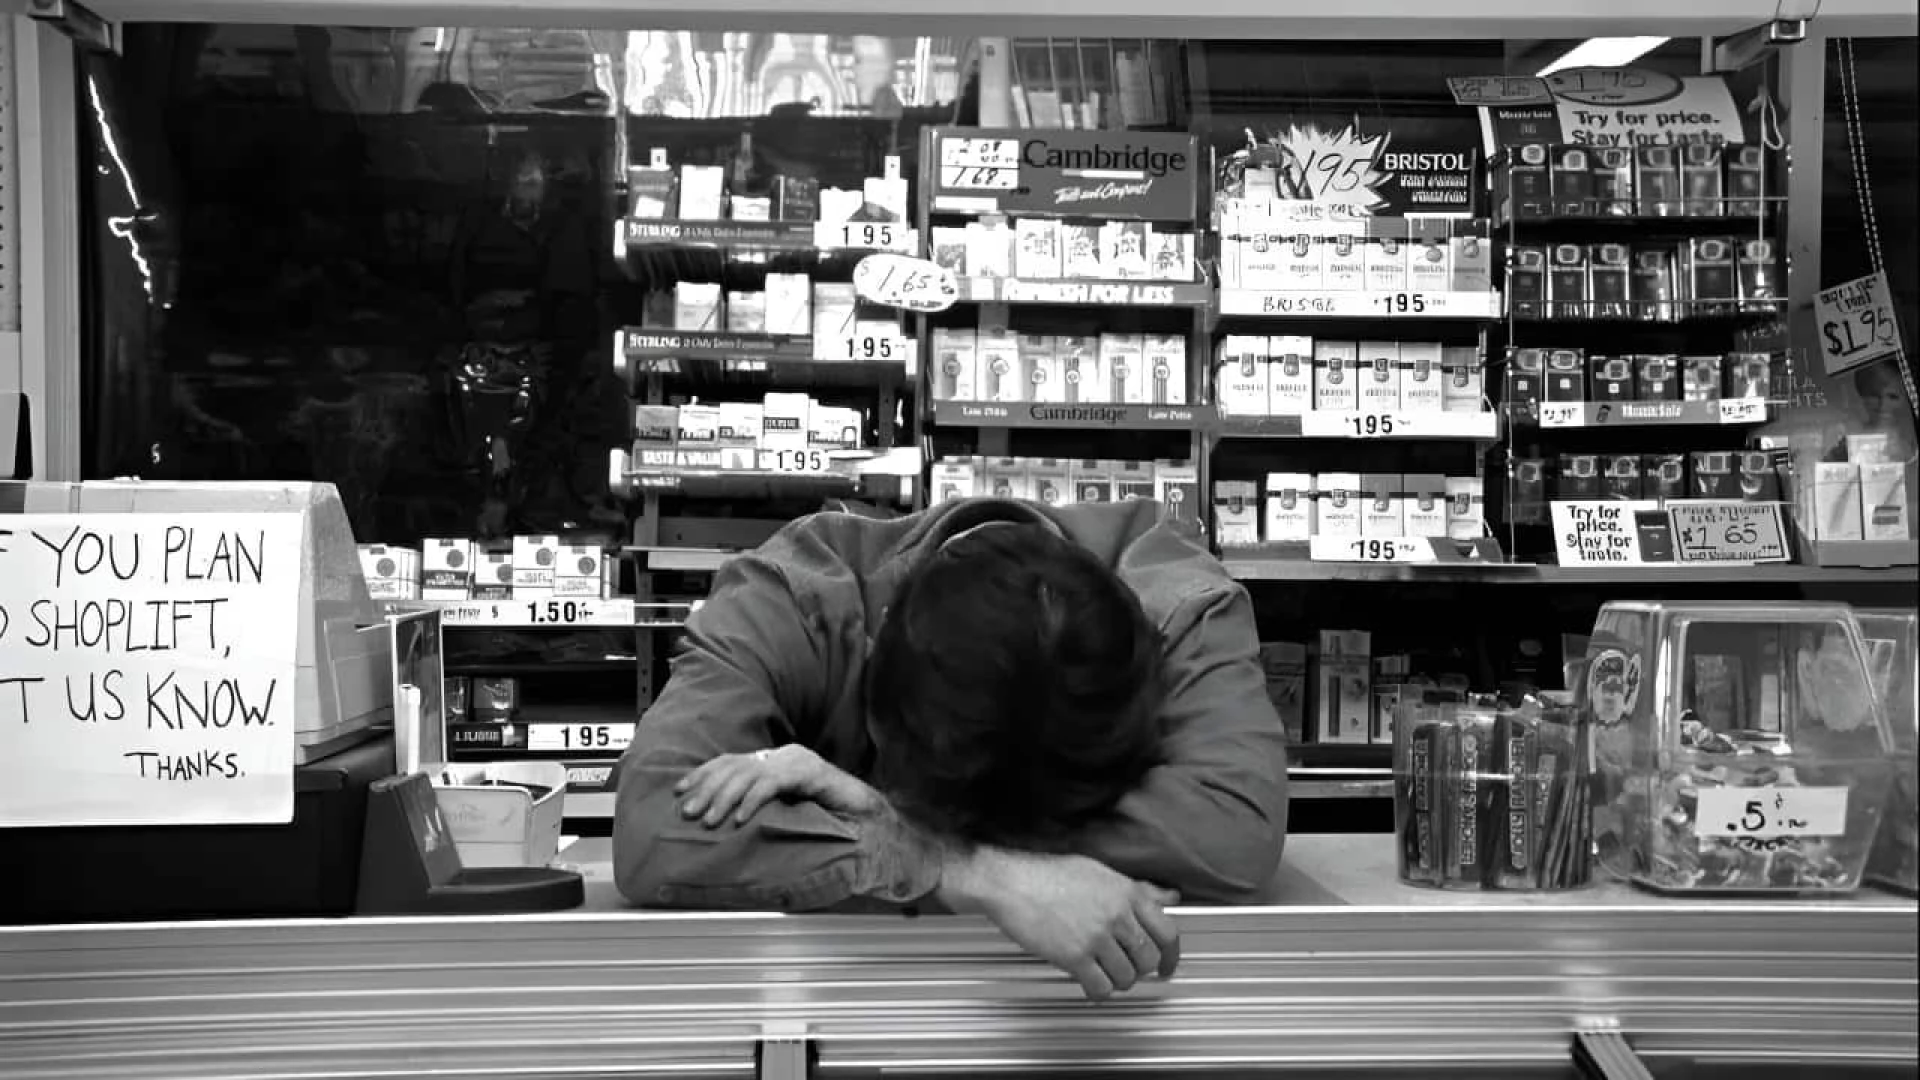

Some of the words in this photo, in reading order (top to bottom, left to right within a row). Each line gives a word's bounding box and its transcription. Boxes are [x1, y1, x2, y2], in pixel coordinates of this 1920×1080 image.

[1572, 110, 1608, 127] Try
[1616, 110, 1648, 125] for
[1655, 110, 1722, 127] price.
[1572, 130, 1621, 146] Stay
[1627, 129, 1660, 145] for
[1023, 139, 1187, 177] Cambridge
[1384, 152, 1471, 171] BRISTOL
[1029, 405, 1128, 425] Cambridge
[1566, 504, 1593, 523] Try
[1598, 504, 1621, 519] for
[1608, 532, 1633, 547] for
[31, 525, 140, 588] YOU
[164, 525, 266, 585] PLAN
[528, 601, 577, 622] 1.50
[25, 597, 232, 658] SHOPLIFT,
[66, 669, 126, 722] US
[146, 671, 277, 729] KNOW.
[124, 748, 247, 782] THANKS.
